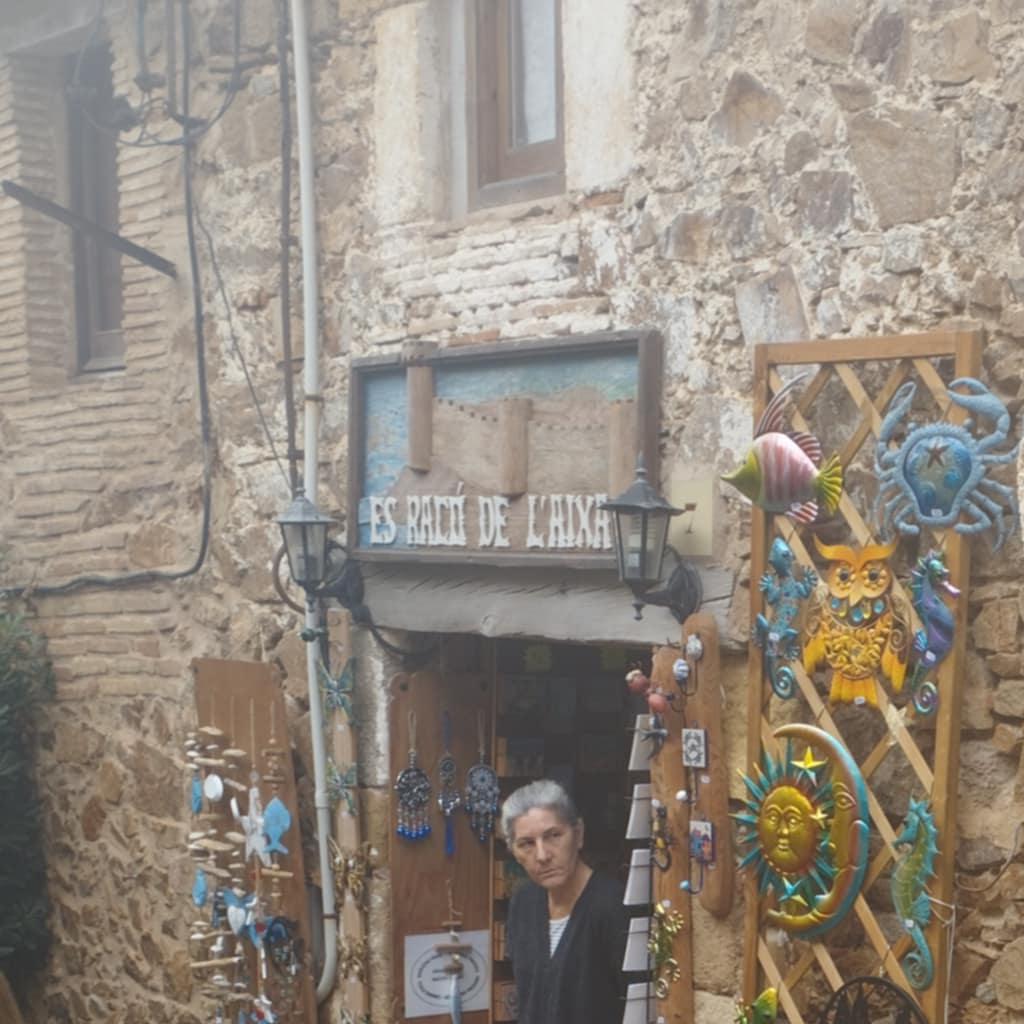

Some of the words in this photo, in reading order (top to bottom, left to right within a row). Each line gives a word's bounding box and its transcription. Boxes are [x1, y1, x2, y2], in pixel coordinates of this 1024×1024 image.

[370, 495, 397, 544] ES
[407, 481, 466, 545] RACÓ
[479, 495, 511, 547] DE
[526, 494, 613, 549] L'AIXA
